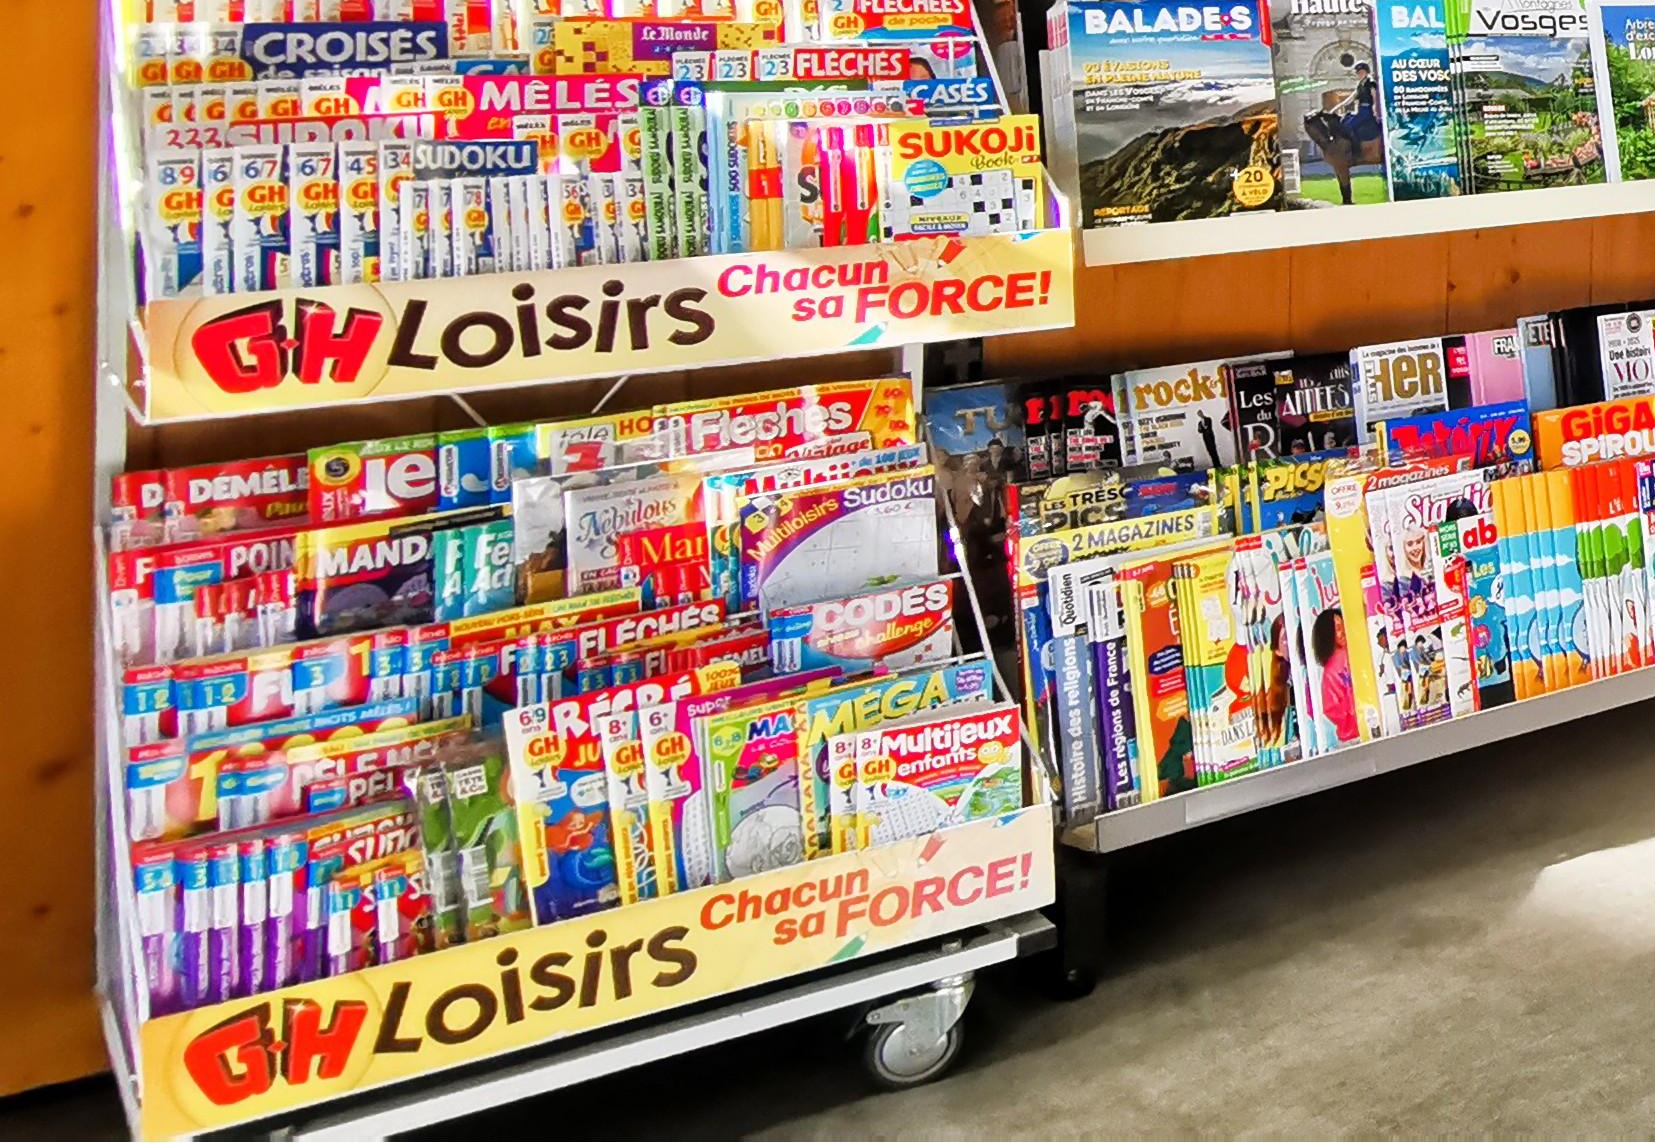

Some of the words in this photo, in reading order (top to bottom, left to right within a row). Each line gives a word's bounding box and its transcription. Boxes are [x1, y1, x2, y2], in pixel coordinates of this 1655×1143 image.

[640, 25, 660, 42] Le
[658, 25, 711, 43] Monde
[888, 16, 906, 25] de
[911, 15, 950, 29] poche
[1476, 10, 1588, 38] Vosges
[253, 29, 436, 64] CROISÉS
[795, 50, 904, 80] FLÉCHÉS
[1106, 72, 1149, 84] PLEINE
[1151, 70, 1202, 81] NATURE
[1391, 60, 1407, 69] AU
[480, 77, 641, 113] MÊLÉS
[910, 78, 988, 104] CASÉS
[415, 142, 533, 172] SUDOKU
[1244, 169, 1264, 183] 20
[716, 260, 889, 298] Chacun
[792, 299, 844, 322] sa
[856, 270, 1053, 324] FORCE!
[386, 279, 716, 370] Loisirs
[1240, 392, 1273, 408] Les
[690, 393, 853, 453] Fléchés
[843, 478, 934, 507] Sudoku
[1368, 476, 1378, 490] 2
[1378, 466, 1450, 488] magazines
[747, 498, 839, 562] Multiloisirs
[1072, 532, 1084, 551] 2
[1086, 514, 1196, 549] MAGAZINES
[811, 581, 951, 632] CODÉS
[855, 615, 934, 653] challenge
[1063, 637, 1081, 702] religions
[1105, 641, 1120, 684] France
[706, 678, 737, 693] JEUX
[1108, 688, 1120, 707] de
[808, 674, 950, 745] MÉGA
[1068, 706, 1084, 737] des
[882, 716, 1013, 755] Multijeux
[897, 750, 978, 775] enfants
[1072, 741, 1087, 804] Histoire
[1116, 766, 1129, 787] Les
[700, 867, 870, 932] Chacun
[772, 908, 827, 946] sa
[834, 851, 1033, 940] FORCE!
[372, 923, 699, 1056] Loisirs
